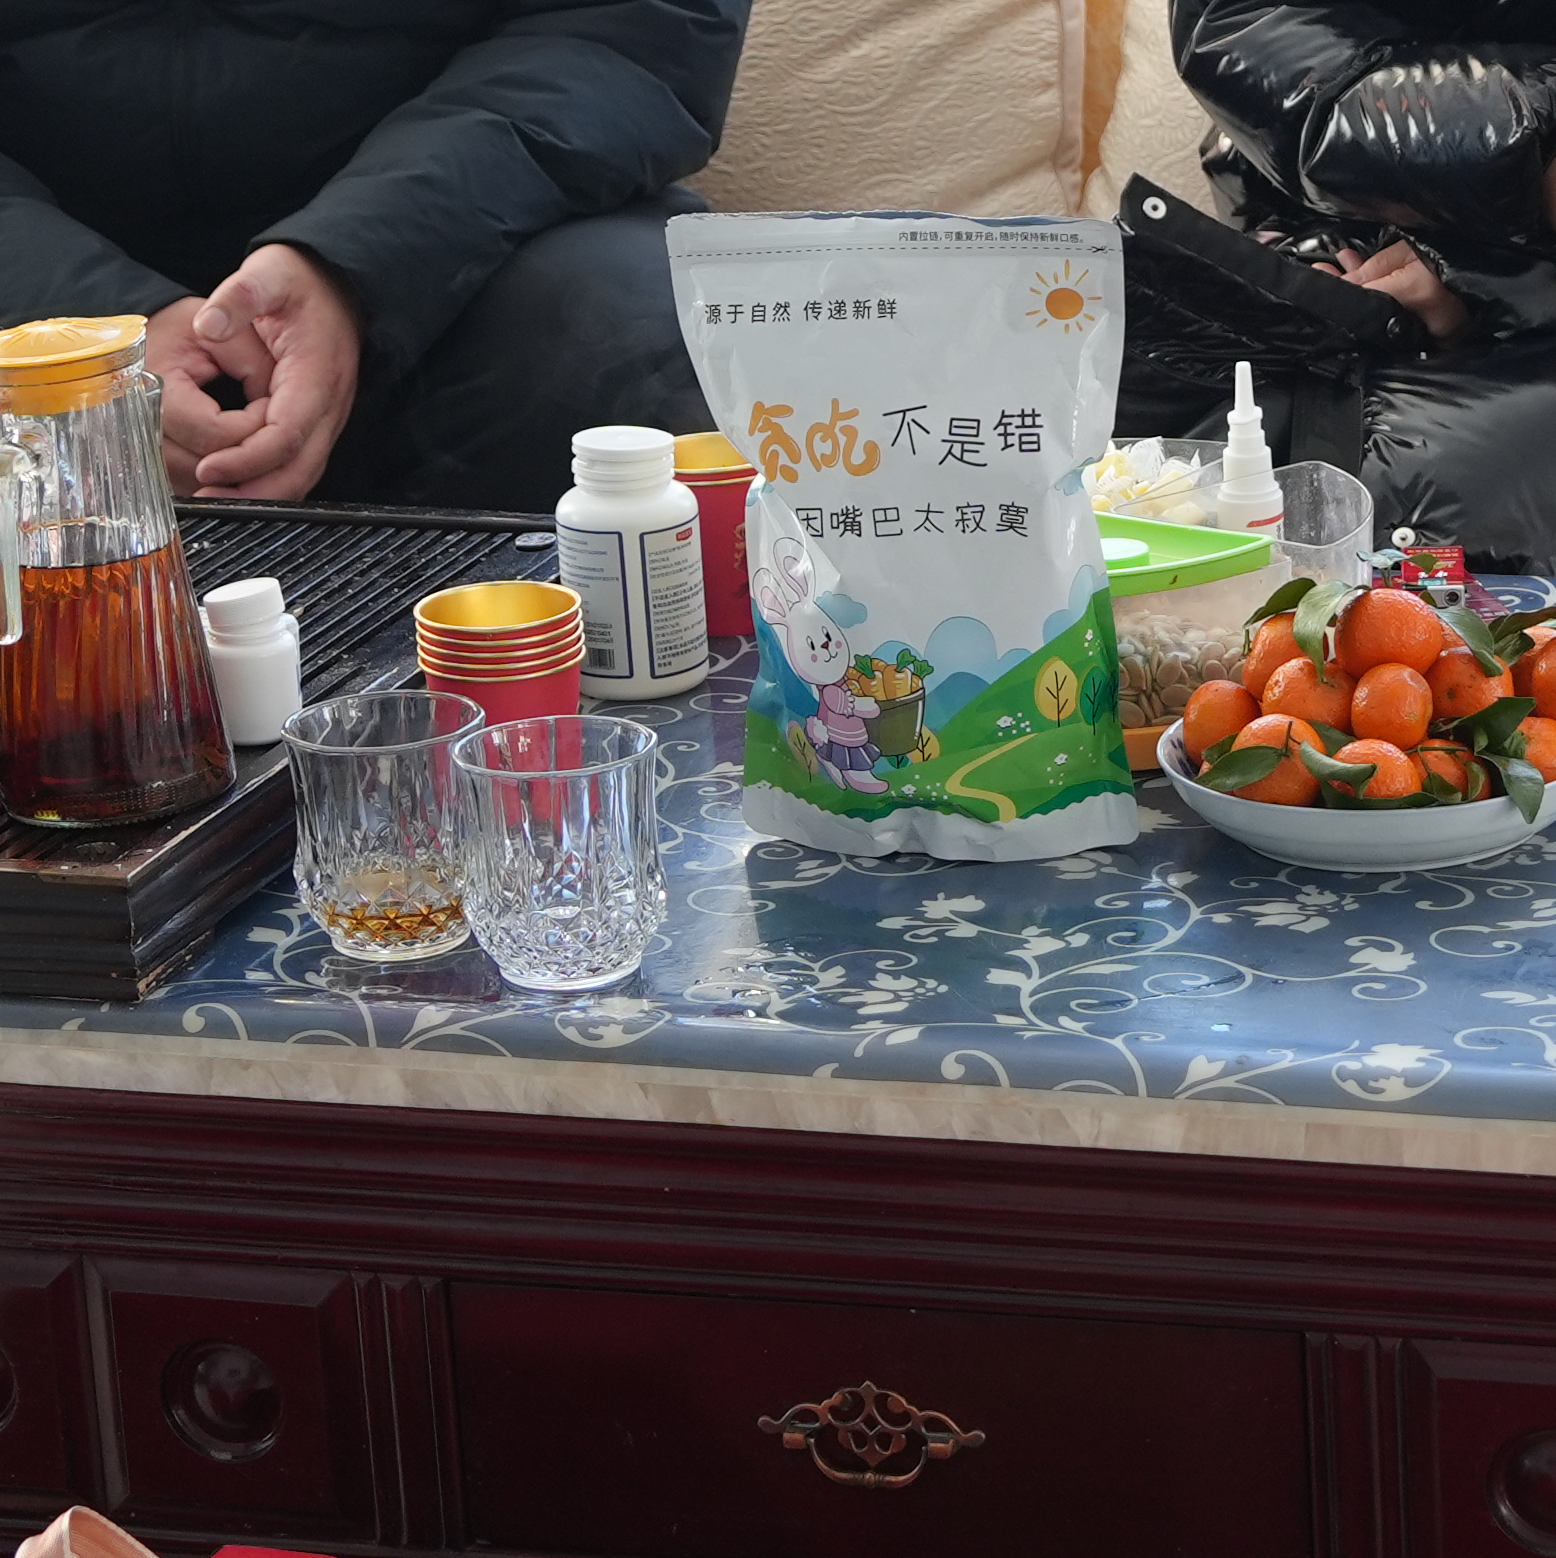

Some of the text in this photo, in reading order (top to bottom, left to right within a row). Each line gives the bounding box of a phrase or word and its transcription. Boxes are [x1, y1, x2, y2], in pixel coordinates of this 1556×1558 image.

[704, 298, 899, 325] 源于自然 传递新鲜
